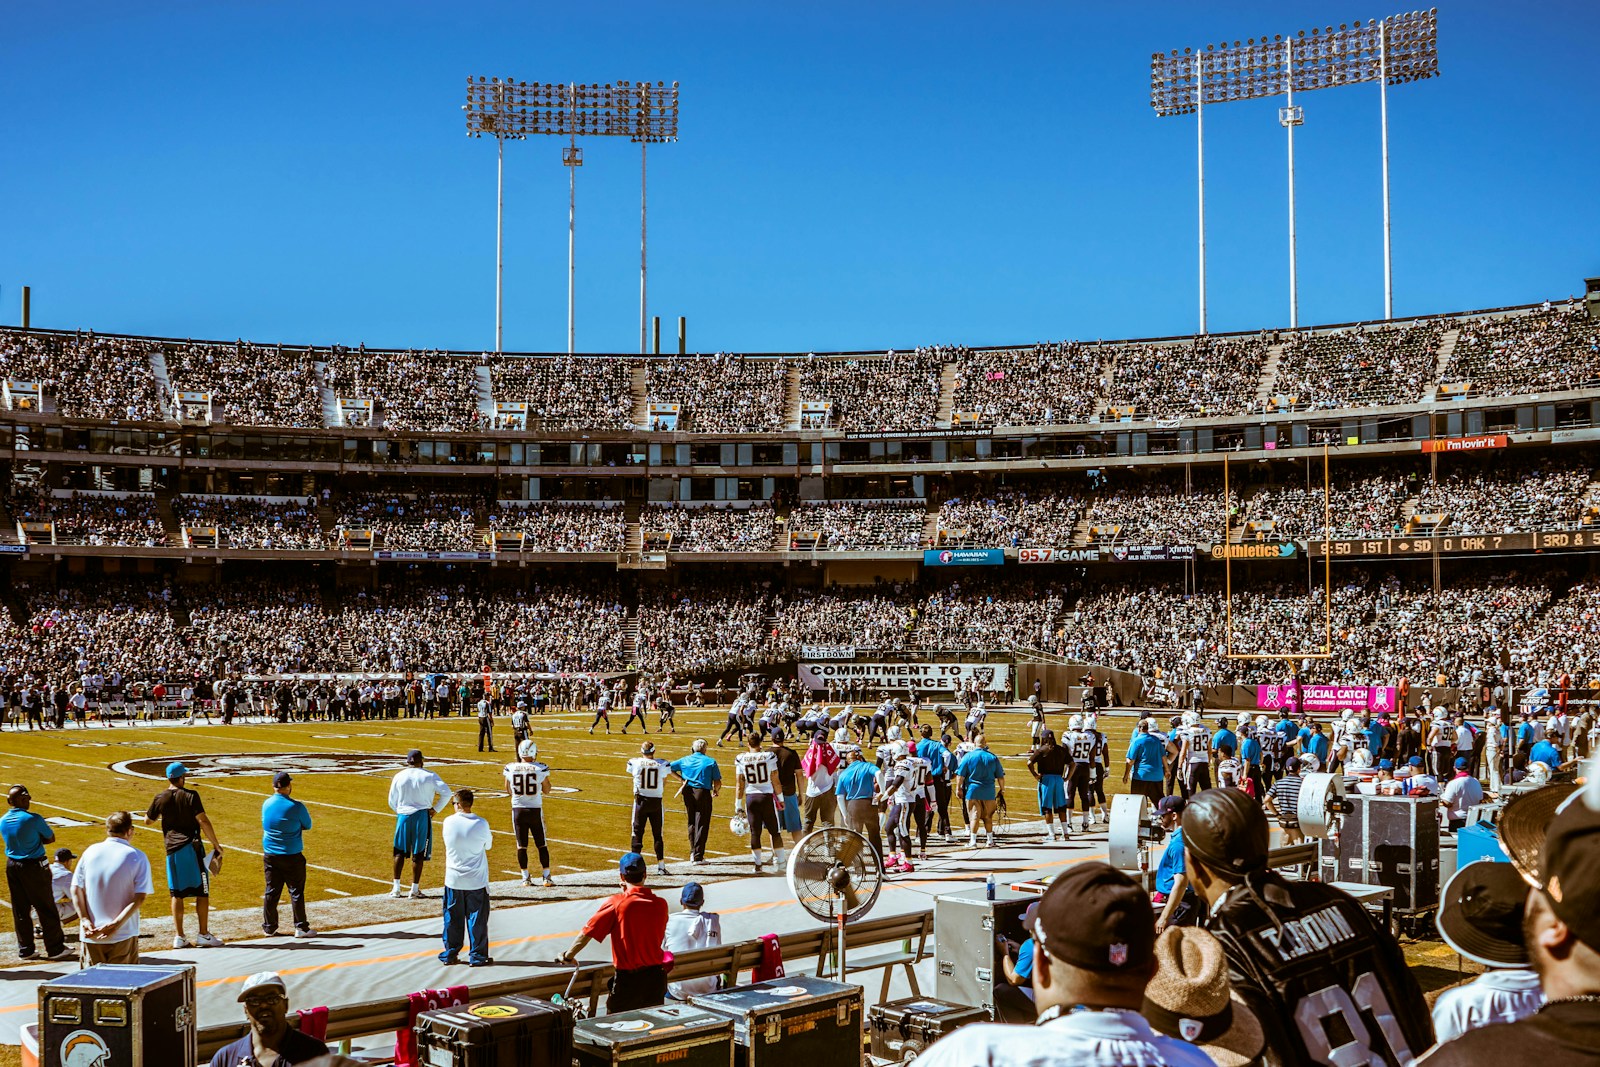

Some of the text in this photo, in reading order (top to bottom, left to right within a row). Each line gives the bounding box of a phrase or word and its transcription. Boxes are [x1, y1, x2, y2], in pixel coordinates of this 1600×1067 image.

[1462, 439, 1486, 448] lovin'
[1488, 438, 1495, 447] it
[1320, 542, 1351, 555] 9:50
[1362, 541, 1383, 553] 1ST
[1413, 540, 1431, 552] SD
[1461, 537, 1485, 550] OAK
[1493, 536, 1502, 549] 7
[1543, 533, 1569, 547] 3RD
[1020, 550, 1052, 562] 95.7
[1058, 550, 1099, 561] GAME
[810, 665, 962, 676] COMMITMENT TO
[1337, 690, 1368, 699] CATCH
[1073, 742, 1091, 759] 69
[1194, 734, 1209, 751] 83
[640, 768, 658, 790] 10
[745, 763, 769, 784] 60
[512, 773, 537, 796] 96
[656, 1048, 689, 1065] FRONT
